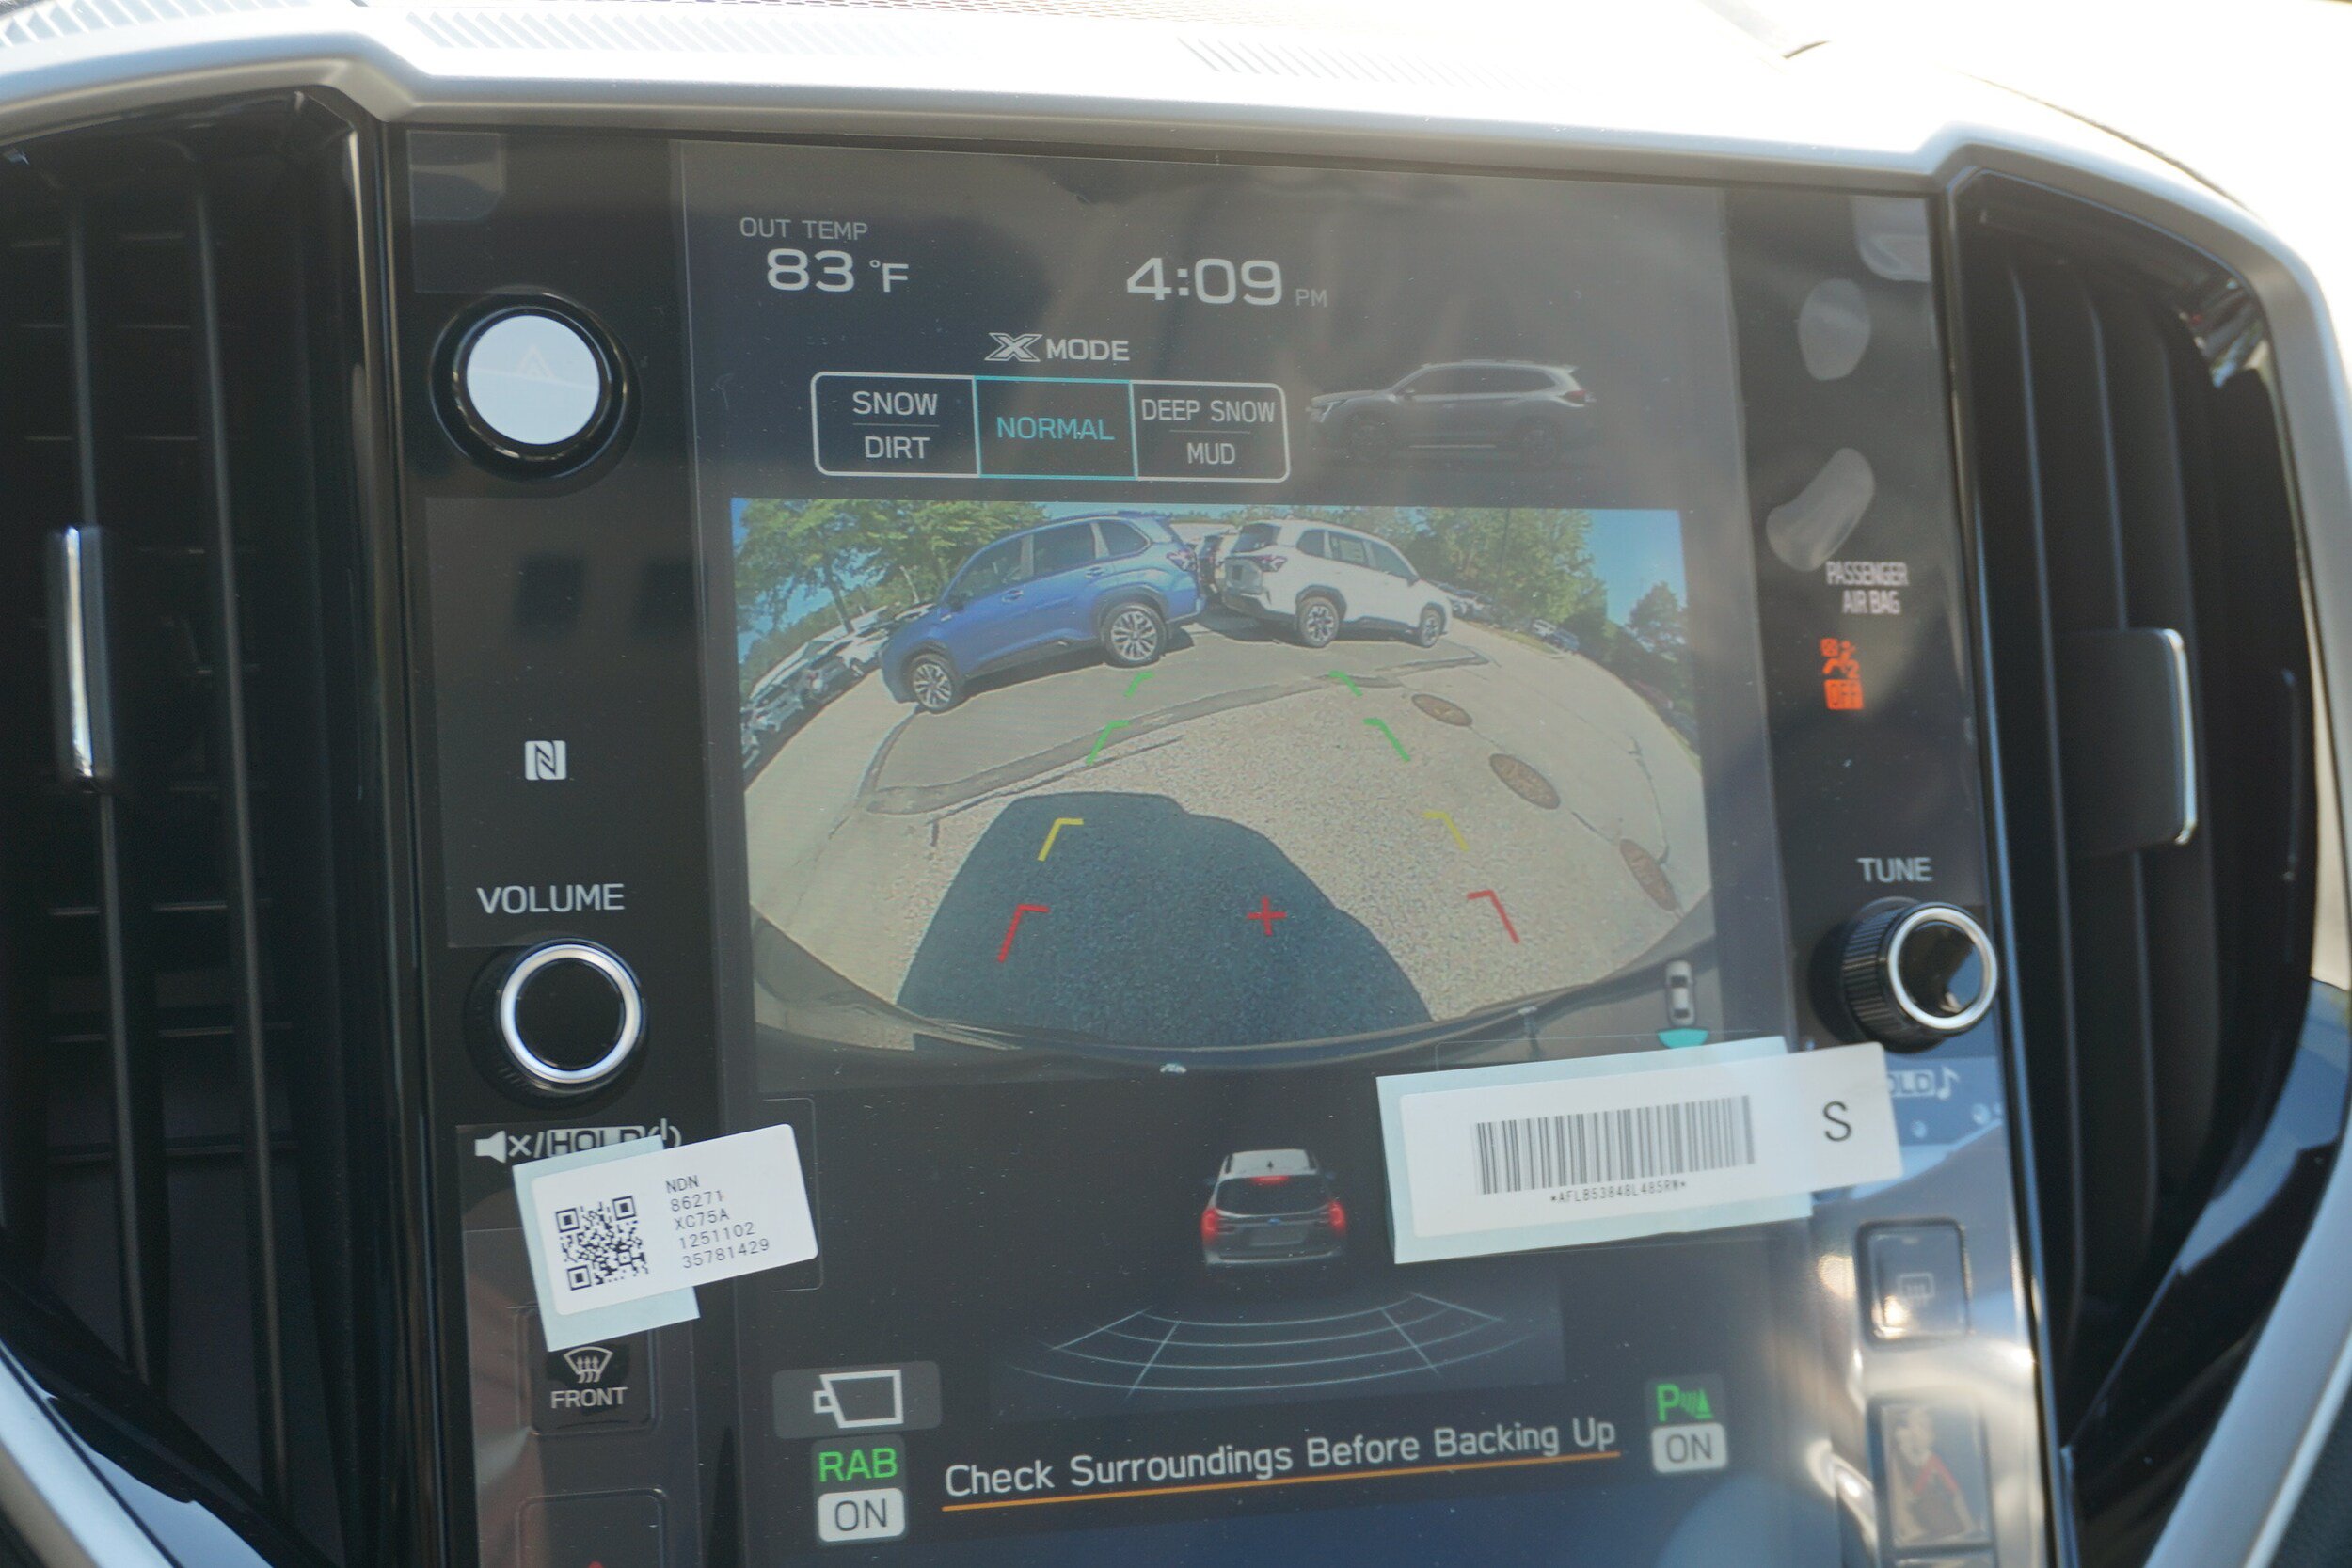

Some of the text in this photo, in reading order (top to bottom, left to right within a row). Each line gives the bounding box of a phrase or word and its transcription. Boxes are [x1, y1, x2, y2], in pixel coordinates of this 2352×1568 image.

[739, 217, 868, 241] OUT TEMP
[767, 249, 855, 292] 83
[1126, 258, 1328, 308] 4:09 PM
[1046, 339, 1130, 362] MODE
[852, 391, 938, 416] SNOW
[1141, 398, 1276, 423] DEEP SNOW
[997, 417, 1115, 441] NORMAL
[865, 436, 930, 460] DIRT
[1187, 442, 1236, 465] MUD
[1826, 561, 1909, 587] PASSENGER
[1842, 589, 1901, 614] AIR BAG
[1857, 857, 1934, 883] TUNE
[477, 883, 626, 914] VOLUME
[1823, 1101, 1851, 1142] S
[666, 1175, 699, 1193] NDN
[671, 1190, 723, 1212] 86271
[675, 1208, 730, 1230] XC75A
[679, 1222, 755, 1249] 1251102
[682, 1238, 770, 1269] 35781429
[551, 1386, 628, 1408] FRONT
[946, 1417, 1616, 1497] Check Surroundings Before Backing Up
[1665, 1433, 1712, 1464] ON
[818, 1448, 898, 1482] RAB
[834, 1498, 887, 1531] ON
